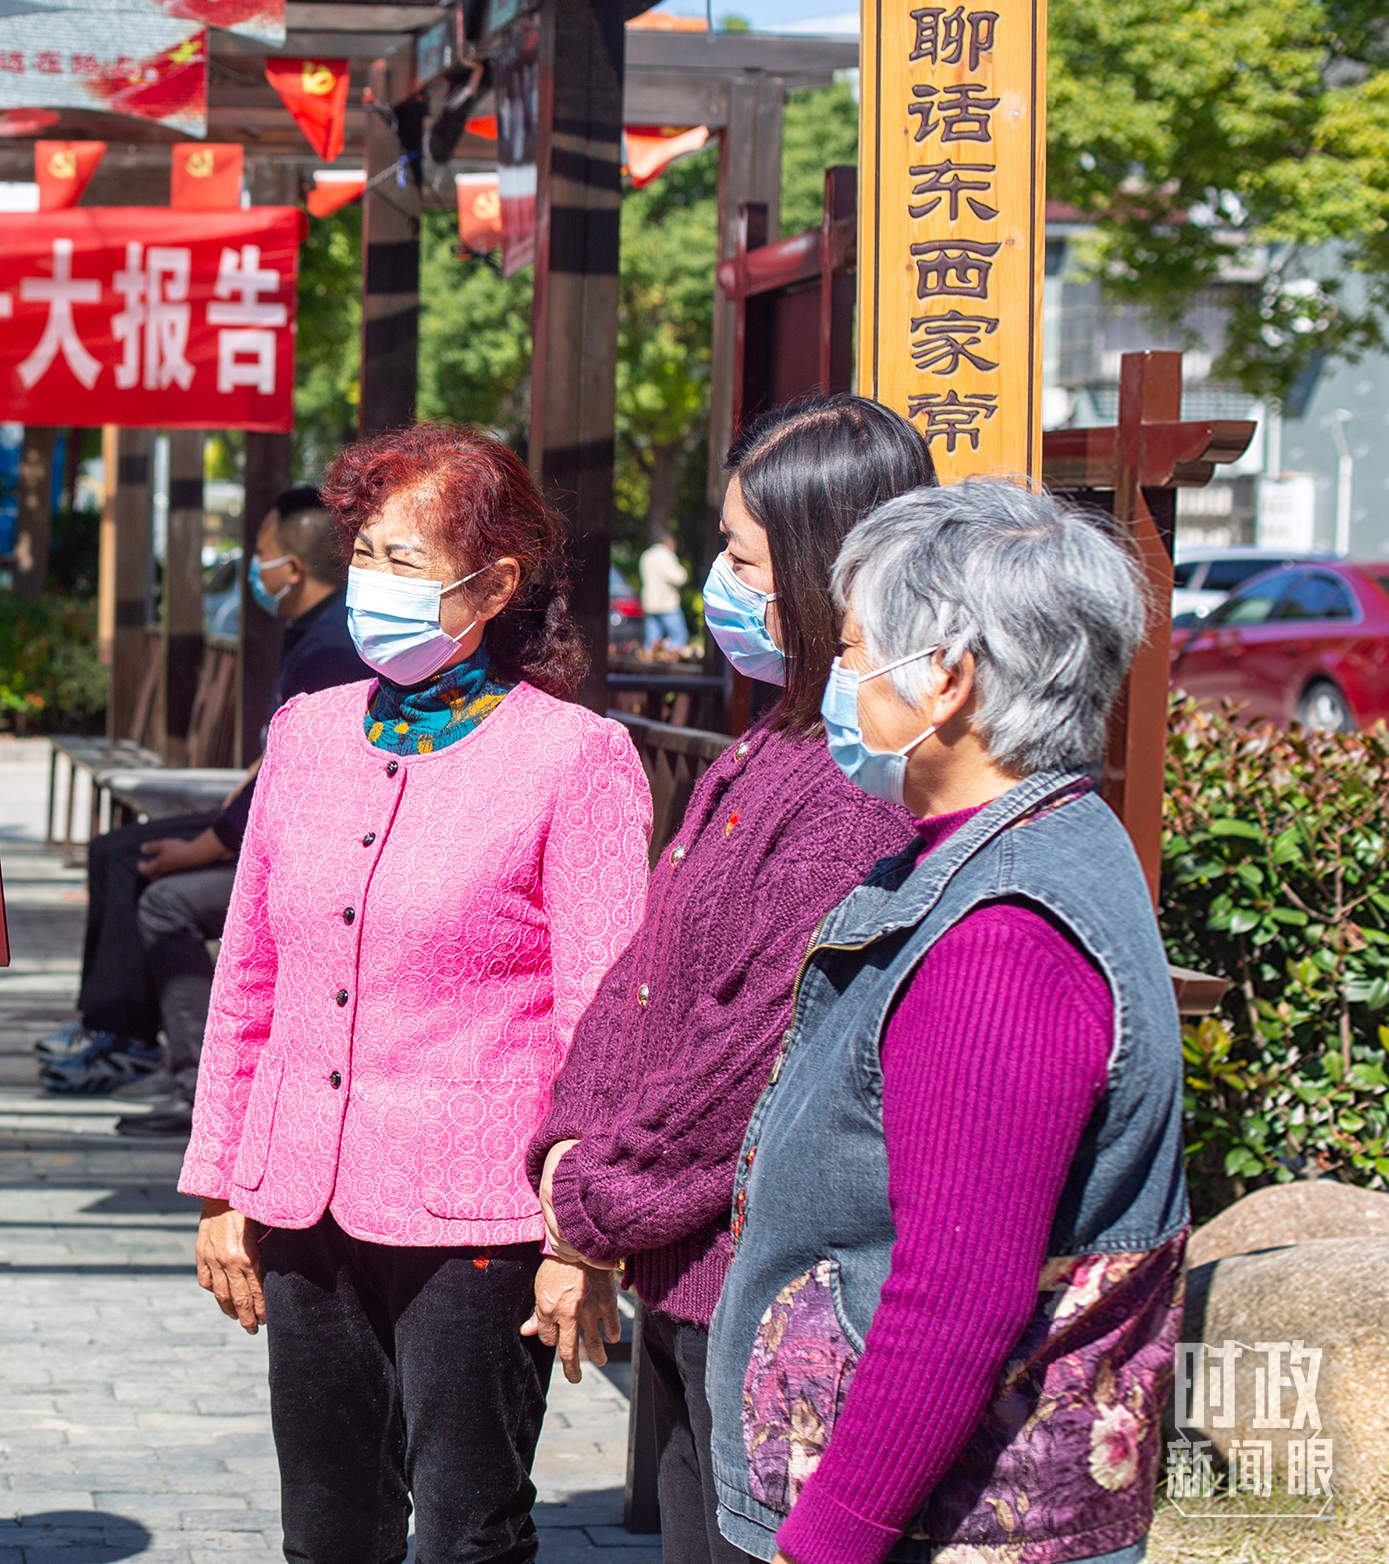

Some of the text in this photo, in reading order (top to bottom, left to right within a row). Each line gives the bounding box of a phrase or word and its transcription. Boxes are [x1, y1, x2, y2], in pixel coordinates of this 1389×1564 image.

[908, 6, 1002, 453] 聊话东西家常
